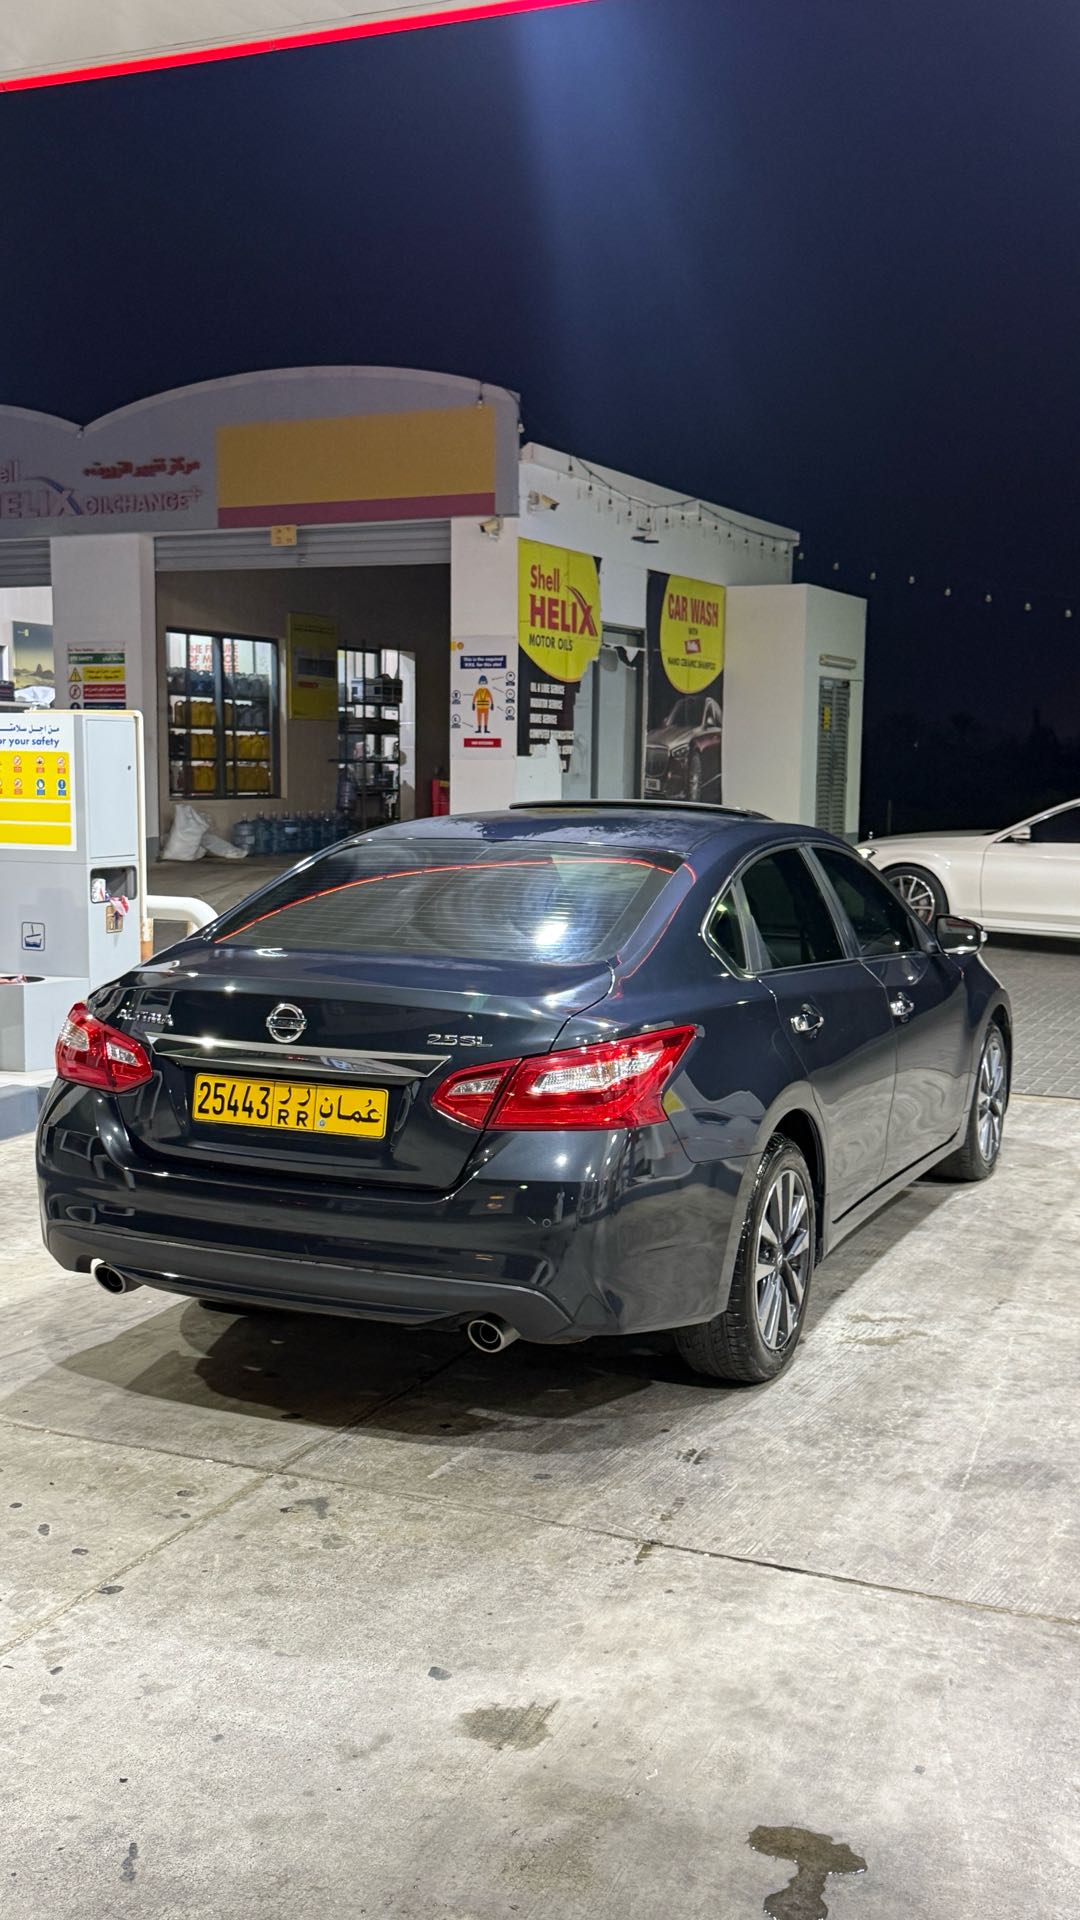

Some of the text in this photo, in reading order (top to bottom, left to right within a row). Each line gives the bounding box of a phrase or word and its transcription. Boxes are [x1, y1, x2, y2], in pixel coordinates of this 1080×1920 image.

[0, 486, 82, 519] ELIX
[530, 564, 560, 593] Shell
[529, 592, 598, 637] HELIX
[668, 592, 719, 628] CAR WASH
[529, 633, 573, 651] MOTOR OILS
[9, 739, 30, 748] your
[31, 736, 60, 749] safety
[198, 1081, 271, 1120] 25443
